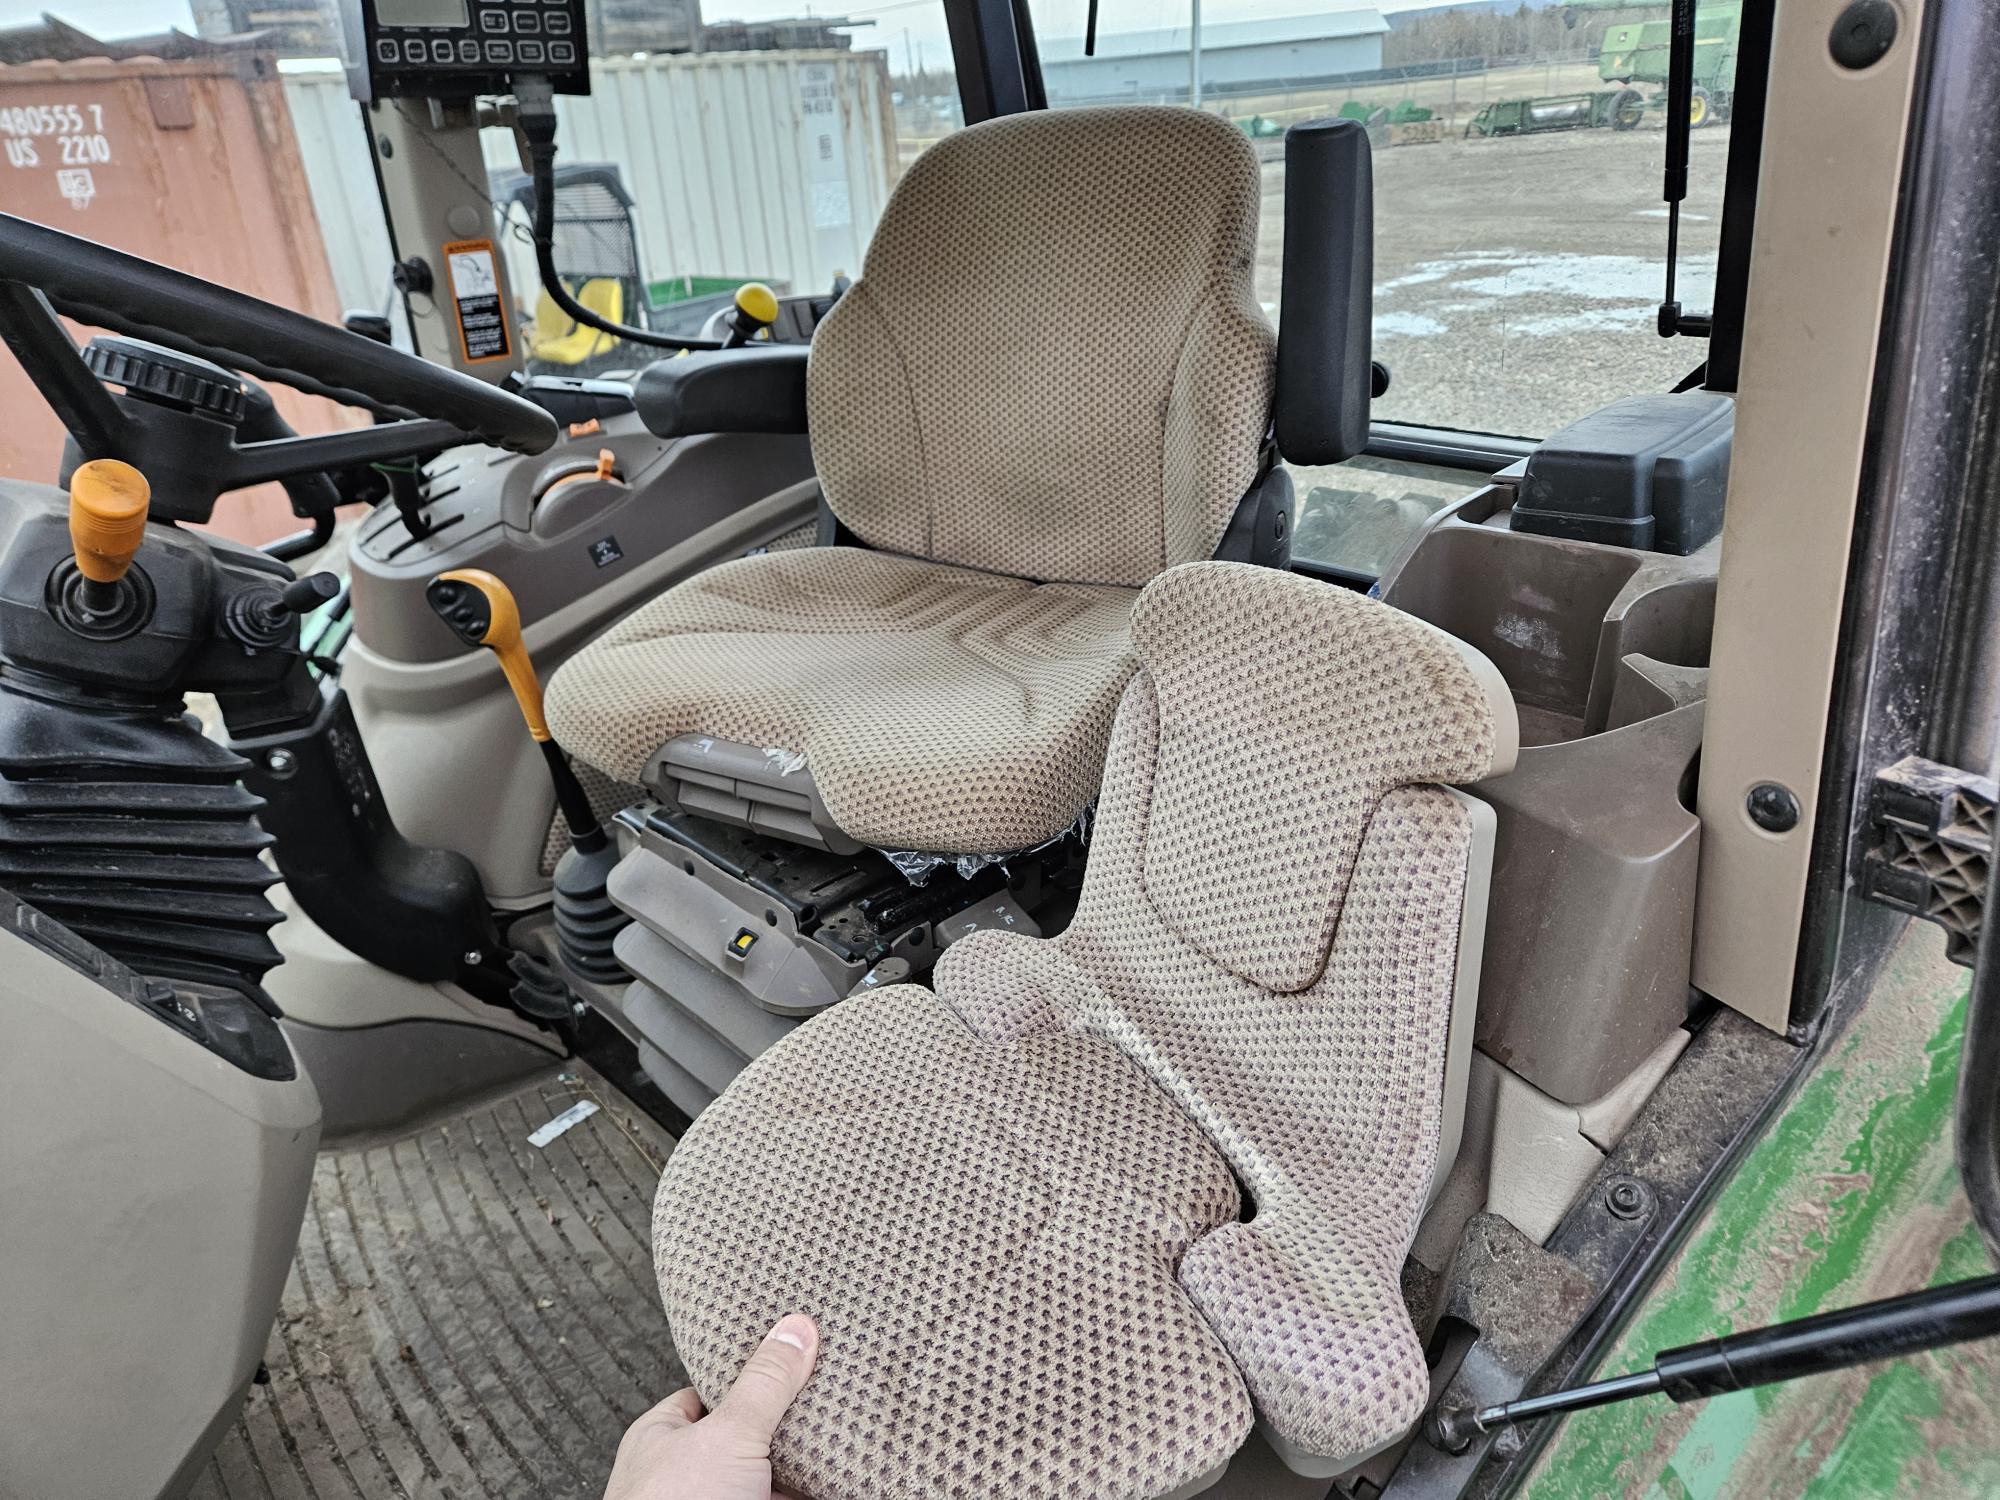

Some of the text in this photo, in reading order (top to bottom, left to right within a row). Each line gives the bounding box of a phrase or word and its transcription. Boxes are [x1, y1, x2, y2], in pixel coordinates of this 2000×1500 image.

[87, 103, 104, 132] 7
[4, 134, 111, 168] US 2210
